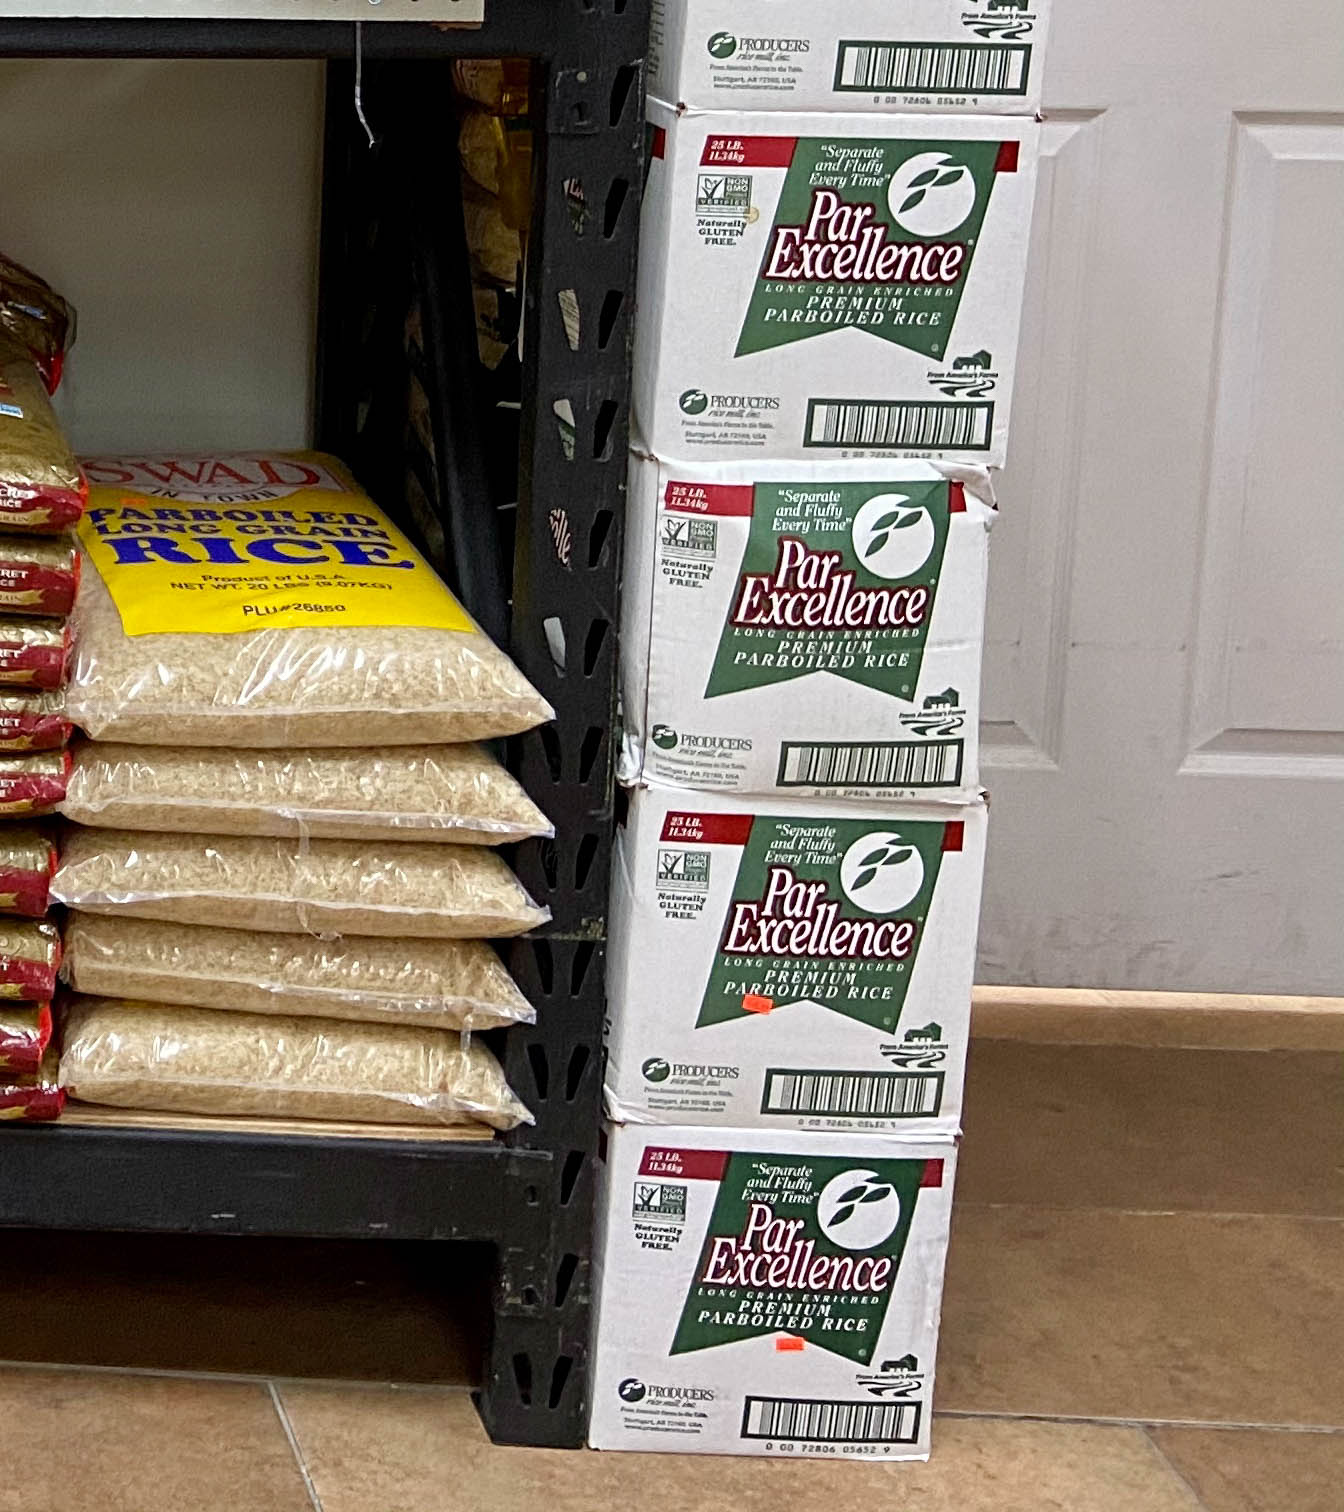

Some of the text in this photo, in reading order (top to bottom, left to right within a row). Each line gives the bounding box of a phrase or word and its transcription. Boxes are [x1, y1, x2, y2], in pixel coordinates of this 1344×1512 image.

[805, 190, 872, 242] Par
[765, 228, 963, 281] Excellence
[103, 536, 415, 570] RICE
[775, 539, 840, 588] Par
[735, 574, 927, 627] Excellence
[761, 869, 826, 919] Par
[725, 903, 913, 958] Excellence
[741, 1204, 804, 1254] Par
[703, 1237, 892, 1292] Excellence
